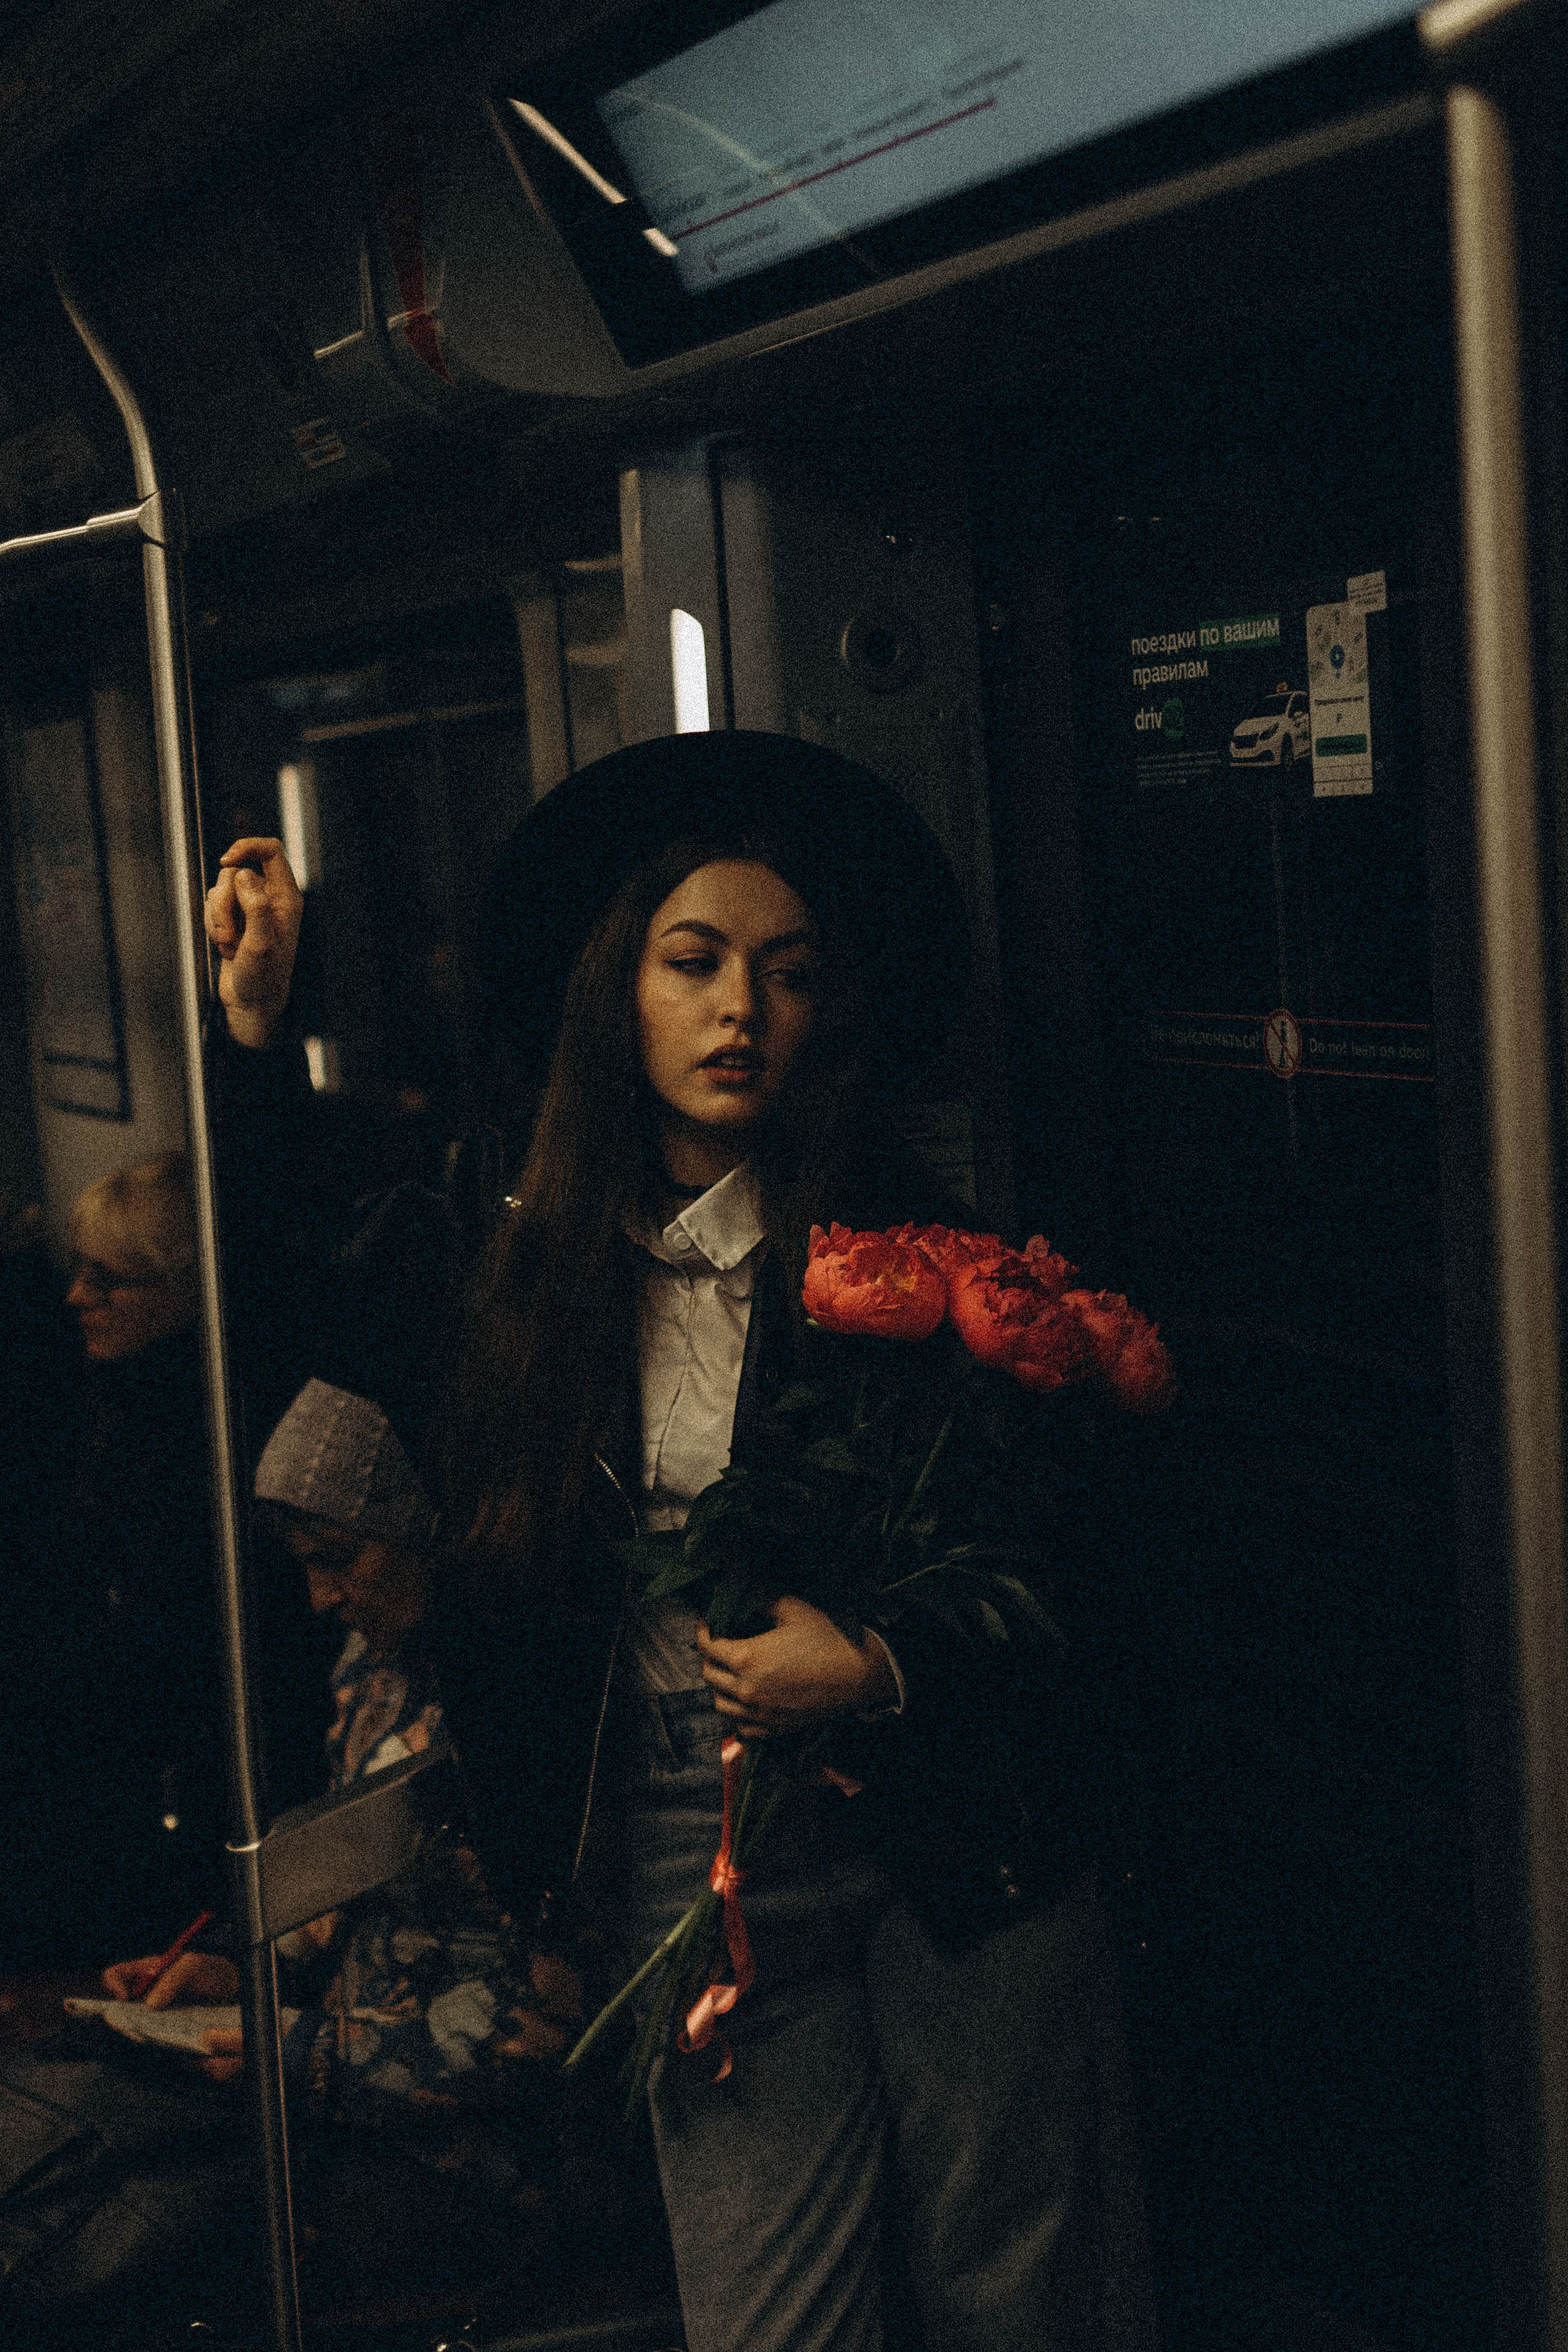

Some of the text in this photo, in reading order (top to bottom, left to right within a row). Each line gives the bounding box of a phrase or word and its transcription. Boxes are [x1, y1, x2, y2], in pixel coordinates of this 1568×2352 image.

[1131, 617, 1280, 655] поездки по вашим
[1133, 660, 1209, 690] правилам
[1309, 1038, 1325, 1054] Do
